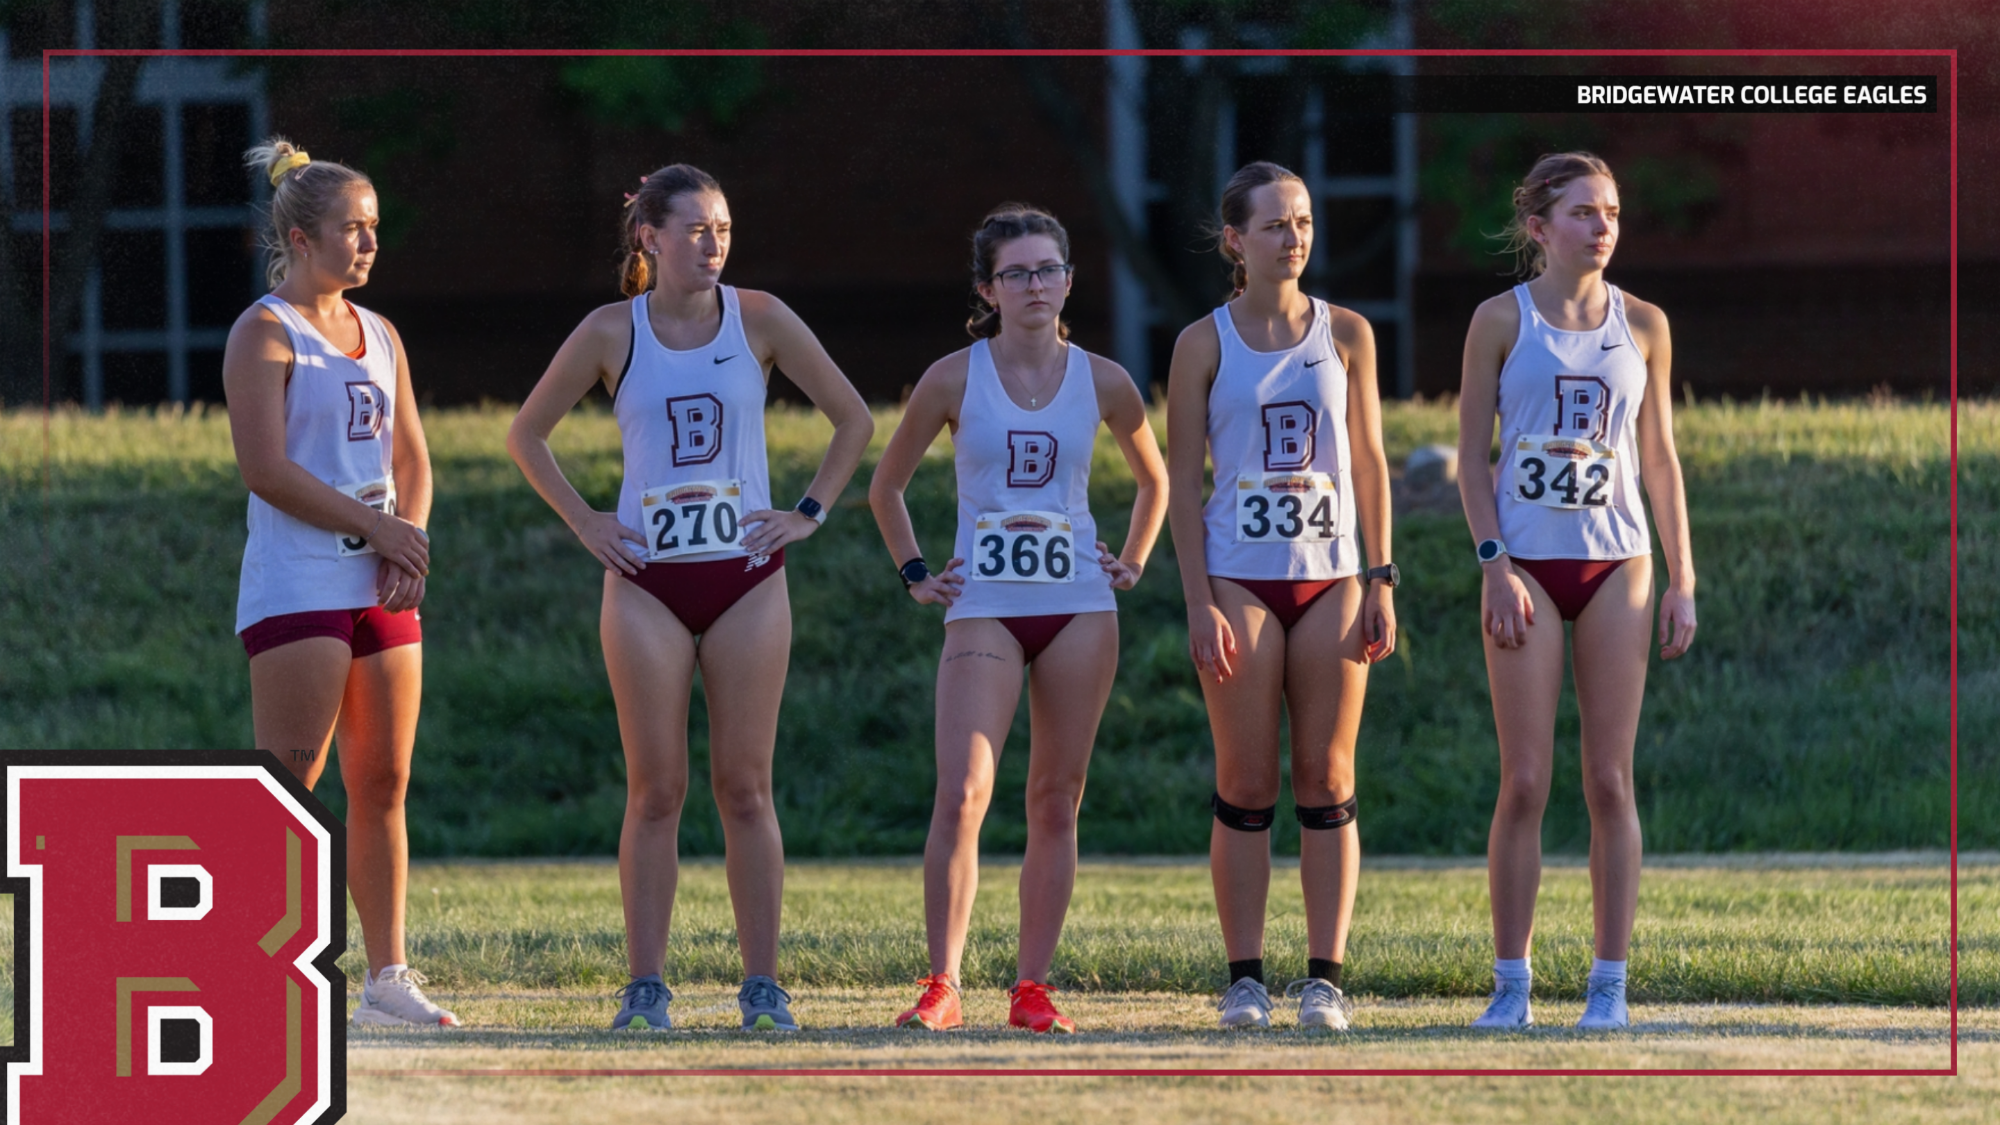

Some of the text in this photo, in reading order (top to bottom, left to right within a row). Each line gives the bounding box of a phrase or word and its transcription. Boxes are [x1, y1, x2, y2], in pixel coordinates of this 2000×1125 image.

[345, 380, 385, 442] B
[666, 392, 723, 468] B
[1261, 399, 1317, 472] B
[1553, 375, 1610, 441] B
[1007, 430, 1058, 488] B
[1519, 457, 1610, 506] 342
[652, 501, 738, 551] 270
[1242, 495, 1334, 538] 334
[978, 534, 1071, 579] 366
